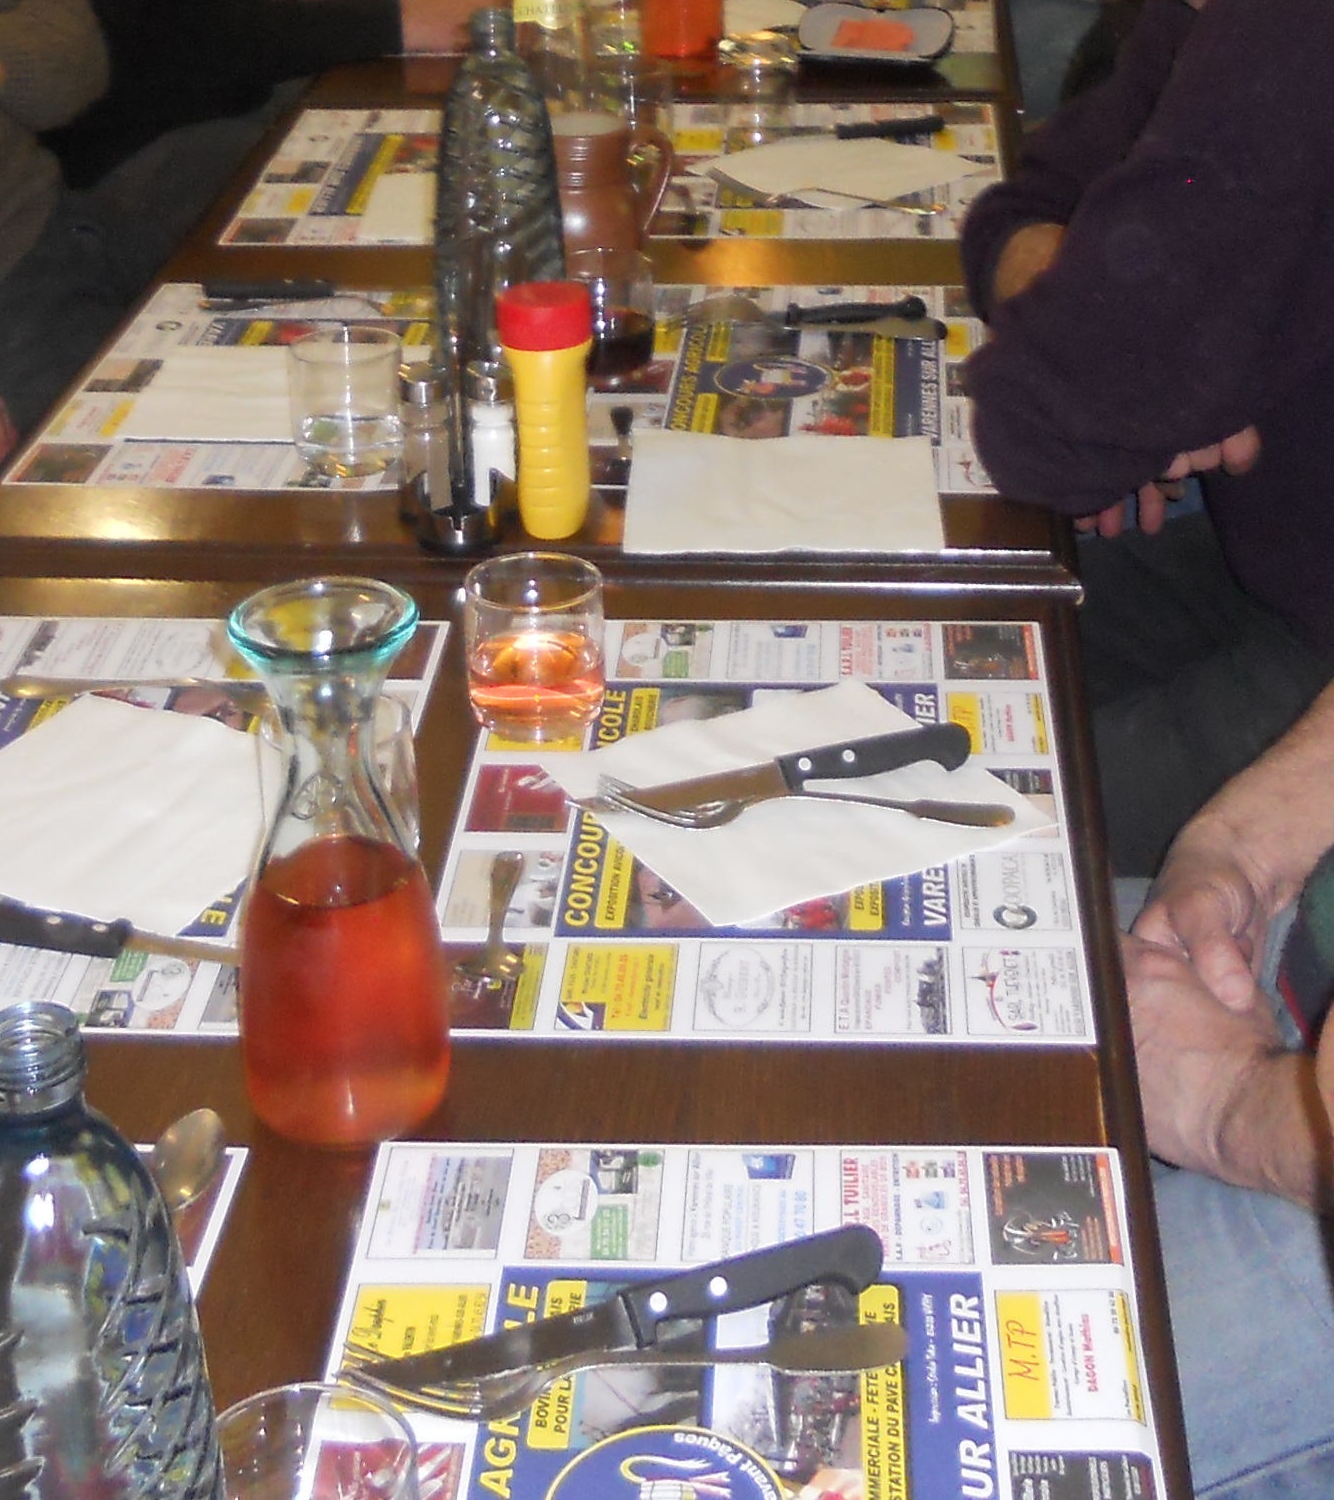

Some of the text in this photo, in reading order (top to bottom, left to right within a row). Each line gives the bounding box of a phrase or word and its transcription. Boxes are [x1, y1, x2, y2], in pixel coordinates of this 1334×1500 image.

[683, 323, 707, 373] AGRICOL
[670, 374, 697, 430] ONCOURS
[598, 689, 626, 745] ICOLE
[563, 811, 604, 926] CONCOUR
[843, 1157, 859, 1205] TUILIER
[1003, 1317, 1040, 1382] M.TP
[479, 1282, 538, 1498] AGRLE
[554, 1395, 569, 1433] POUR
[885, 1381, 898, 1412] PAVE
[949, 1293, 993, 1497] UR ALLIER
[887, 1418, 899, 1436] DU
[866, 1417, 881, 1499] MMERCIALE
[886, 1441, 901, 1499] STATION
